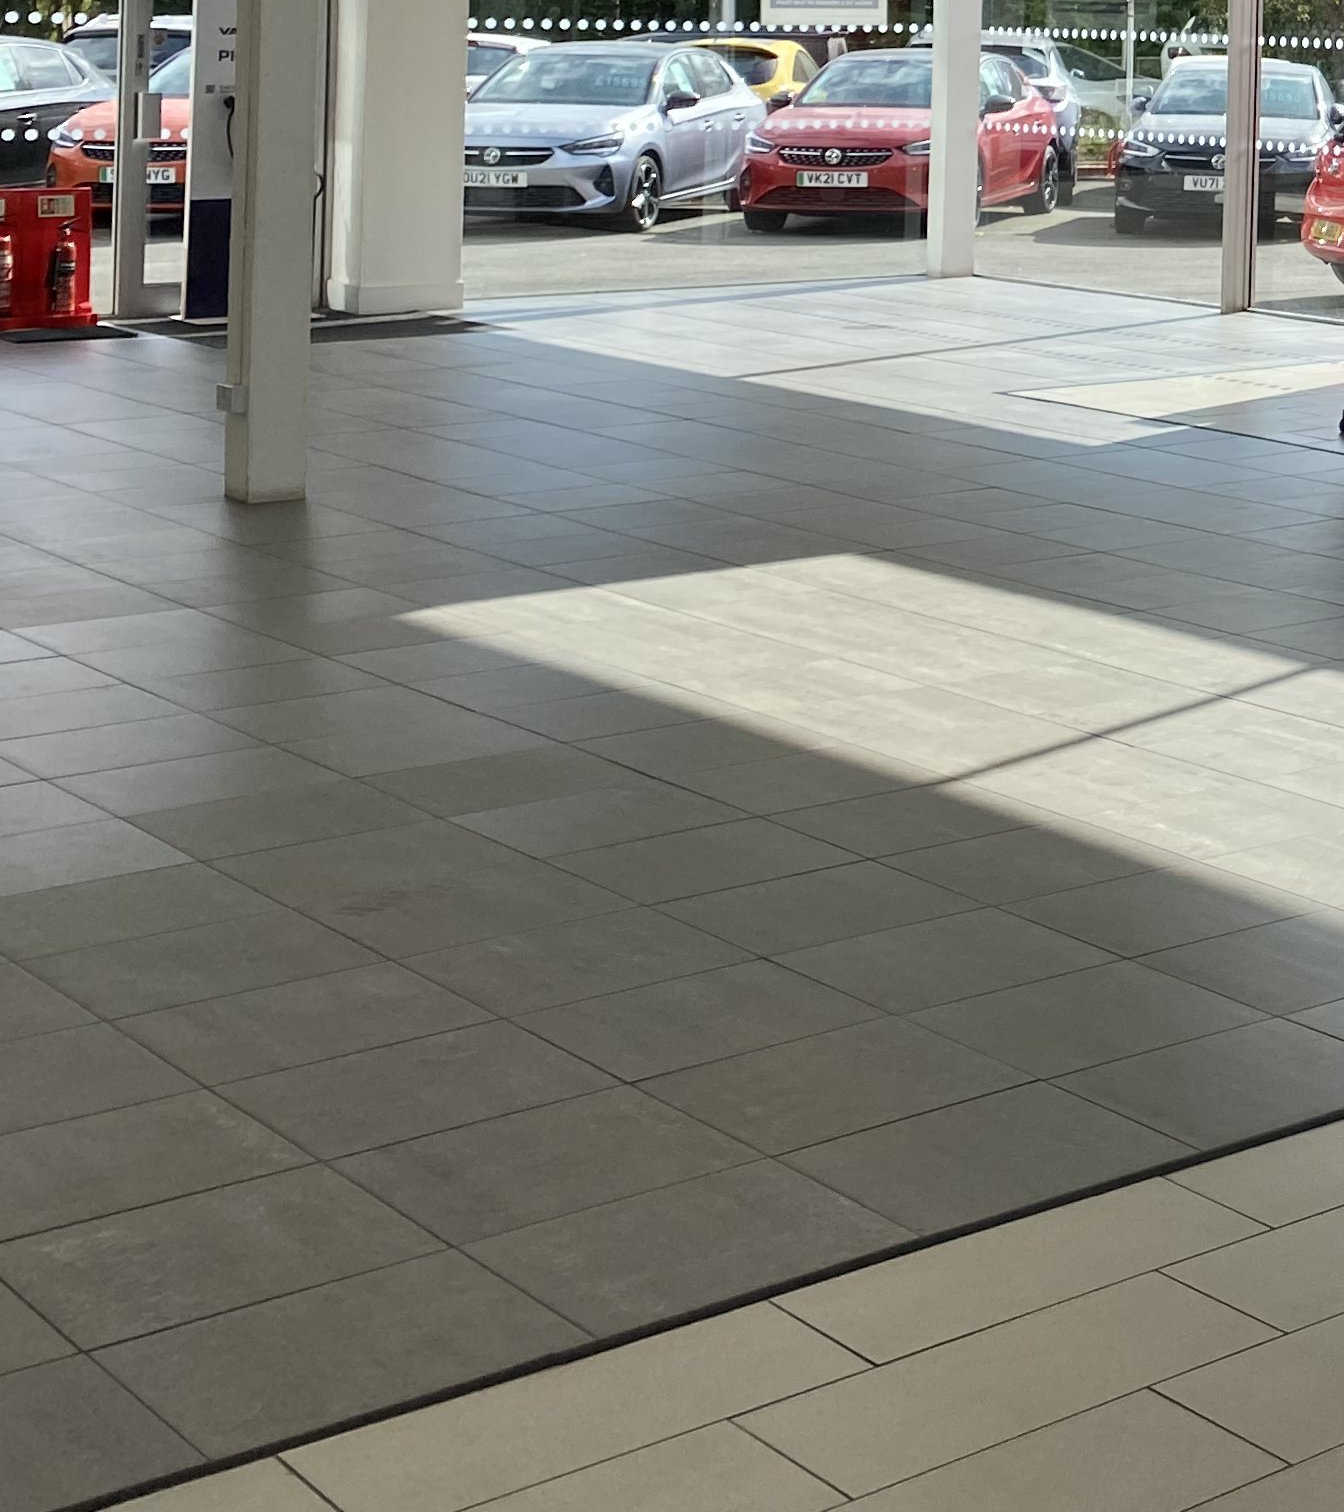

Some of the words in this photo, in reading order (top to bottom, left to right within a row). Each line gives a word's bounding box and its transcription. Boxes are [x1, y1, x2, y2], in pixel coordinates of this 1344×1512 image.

[807, 172, 835, 185] VK21
[838, 173, 862, 185] CVT
[1191, 177, 1219, 189] VU71
